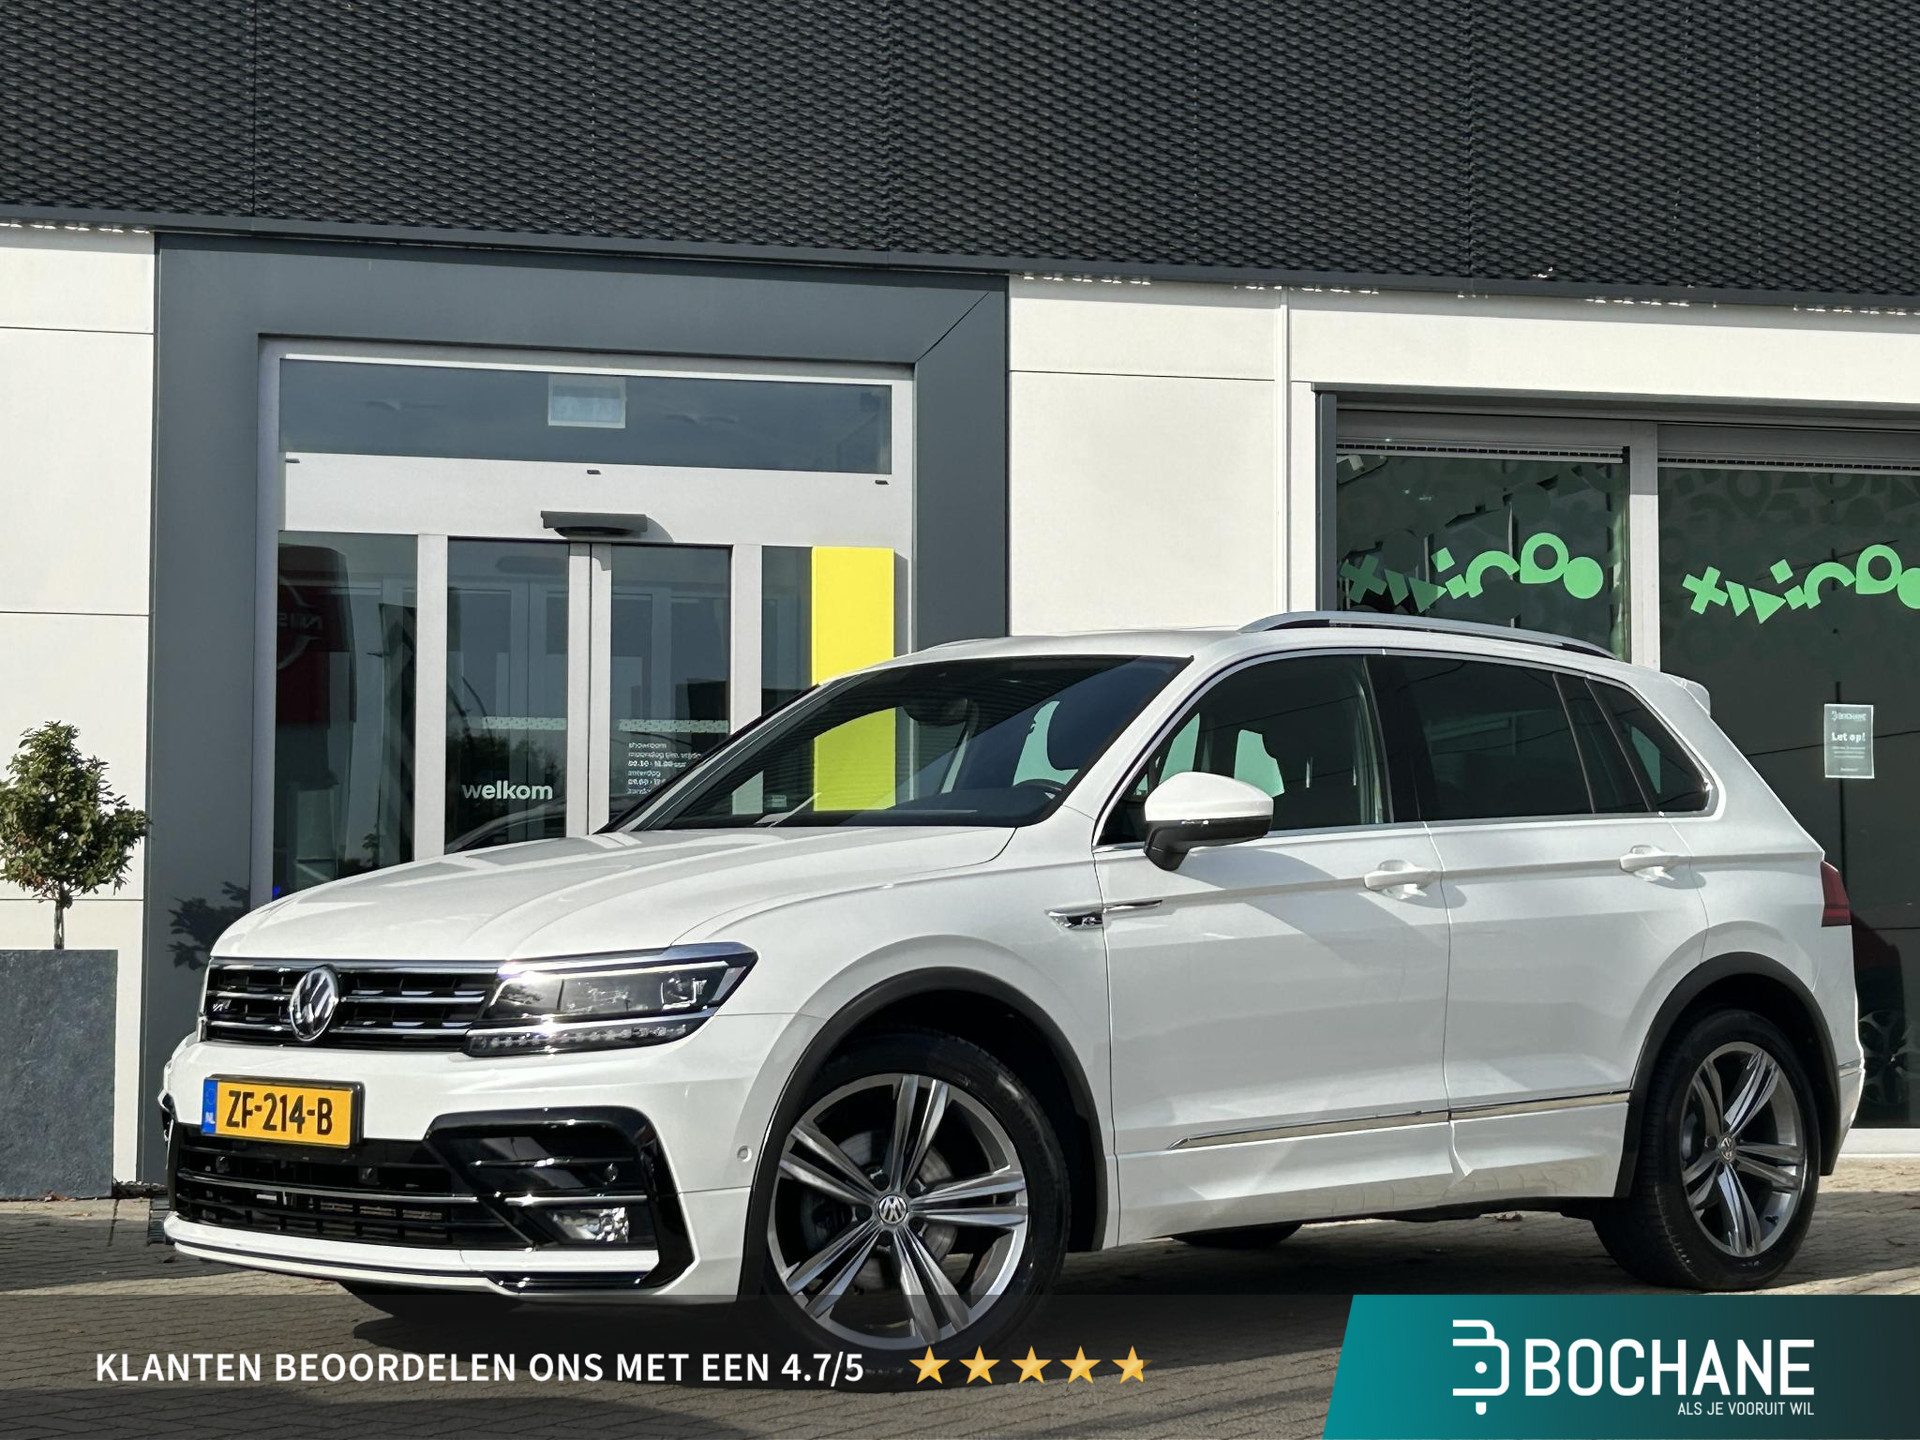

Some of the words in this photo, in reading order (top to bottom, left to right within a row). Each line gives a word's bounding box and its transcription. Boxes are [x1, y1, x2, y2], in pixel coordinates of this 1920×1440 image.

[1832, 731, 1848, 741] Let
[1849, 731, 1866, 743] op!
[461, 780, 553, 800] welkom
[205, 1111, 216, 1125] NL
[226, 1089, 333, 1136] ZF-214-B
